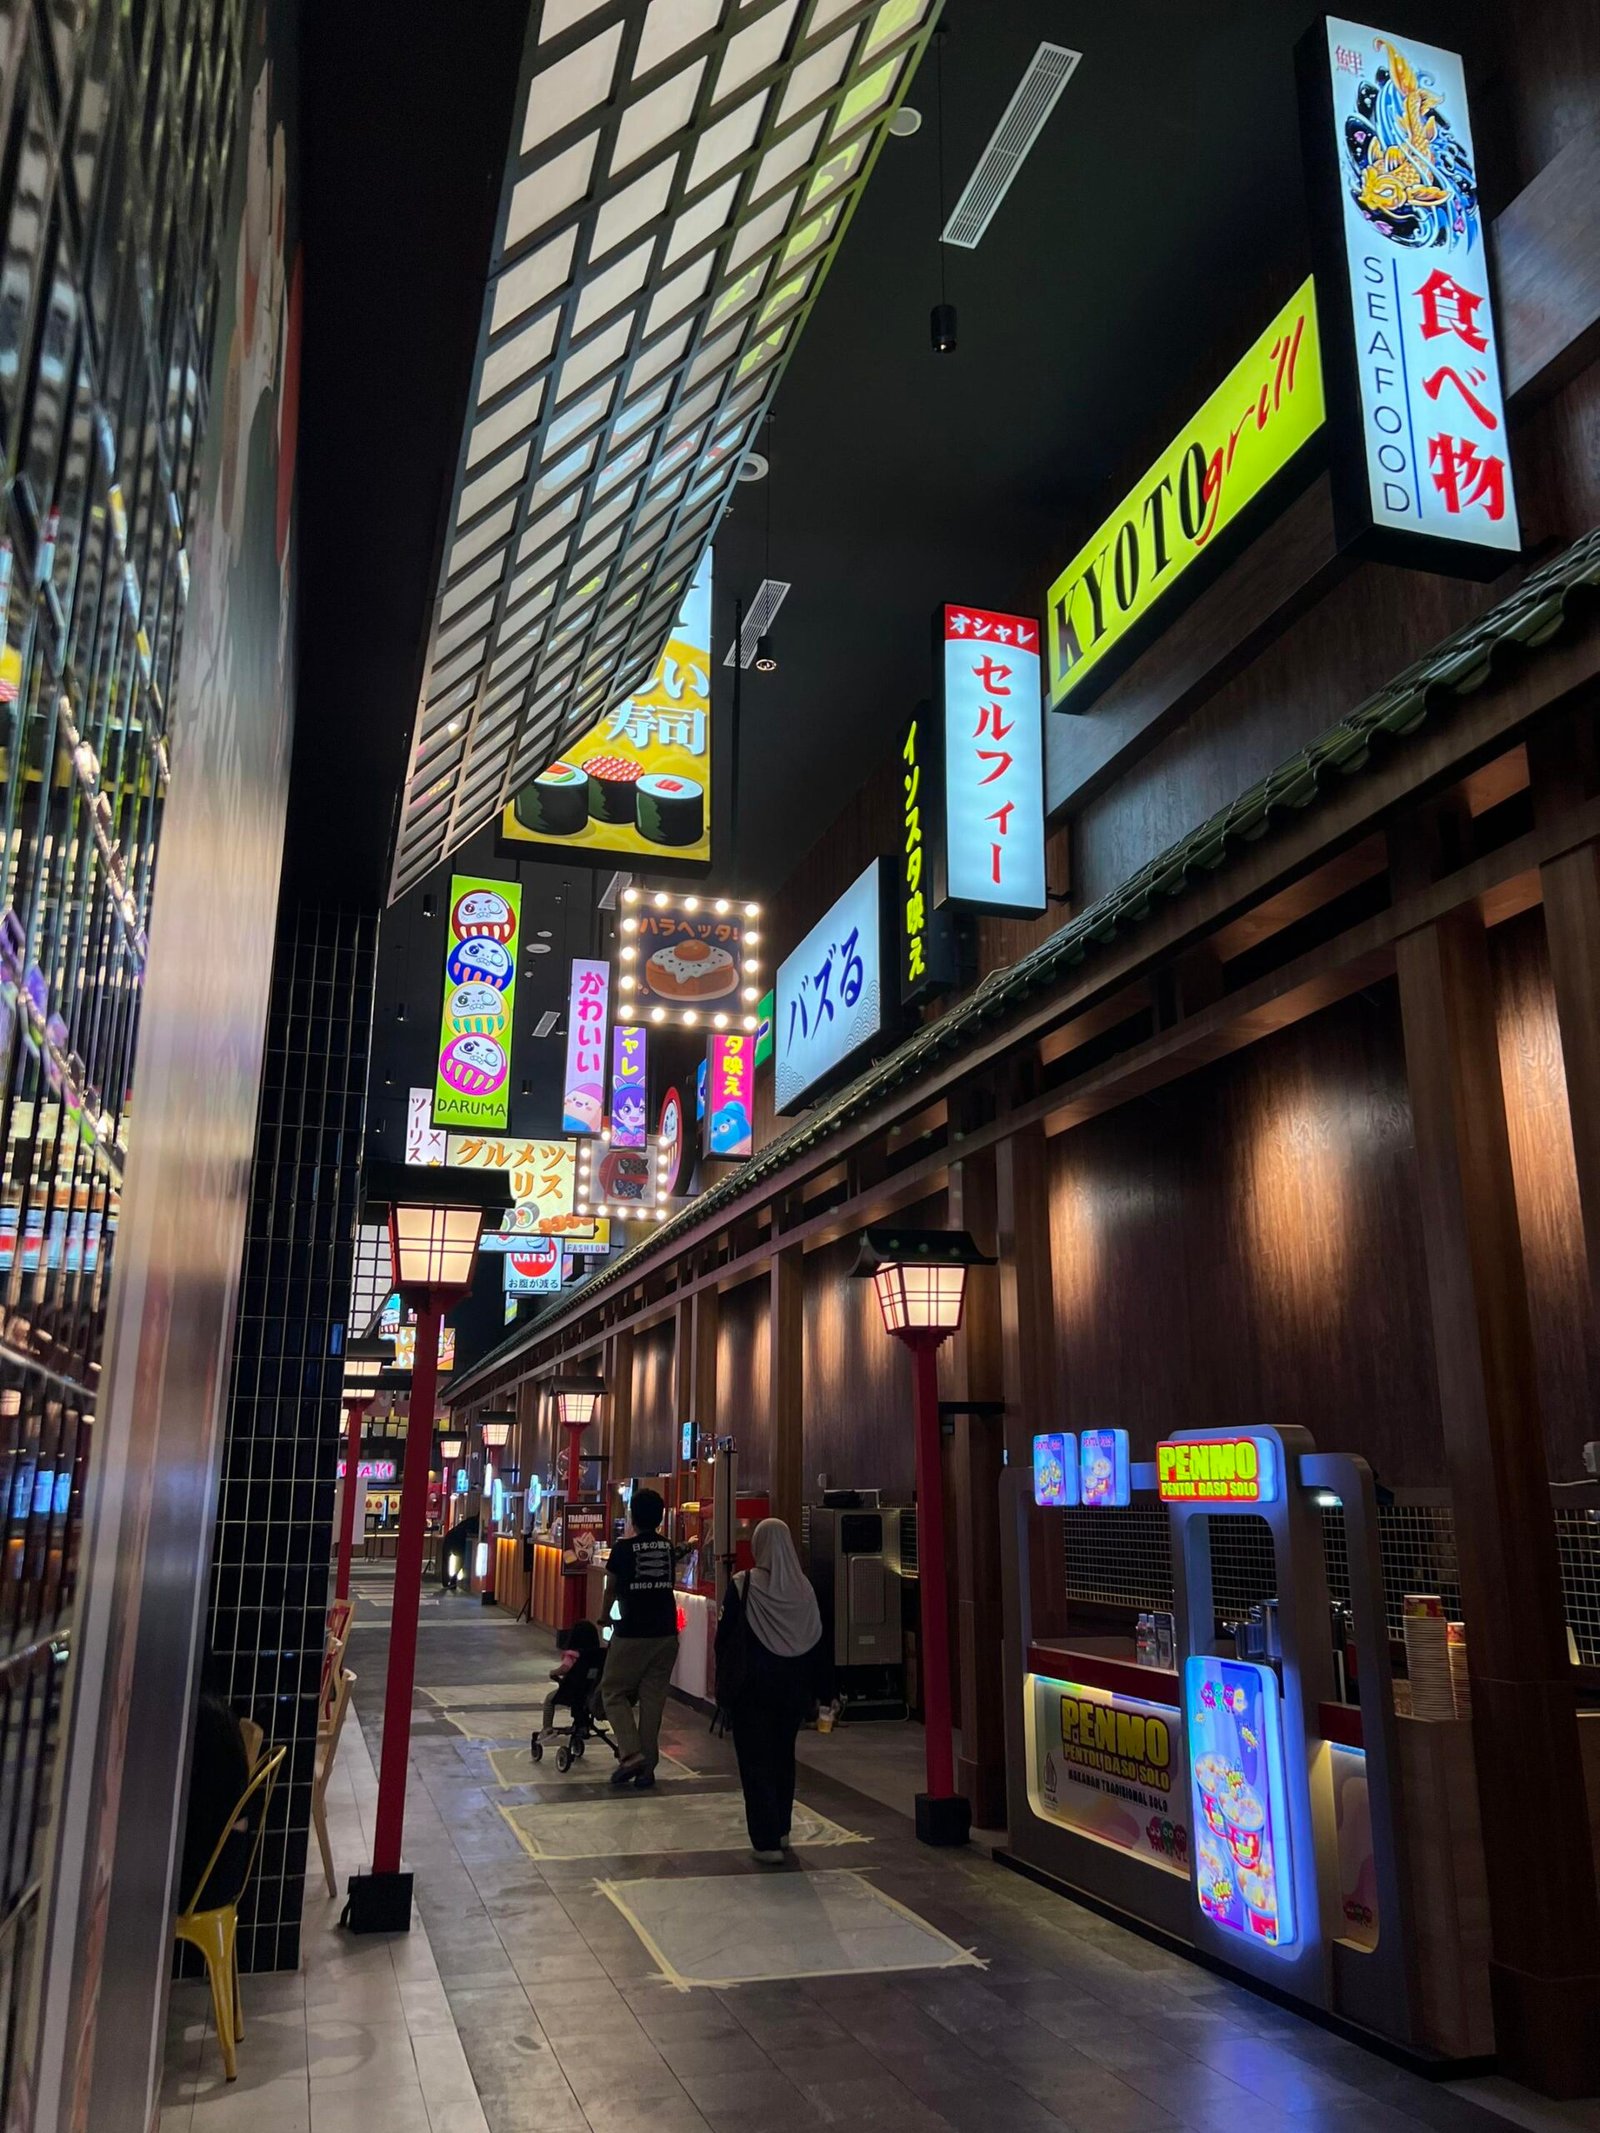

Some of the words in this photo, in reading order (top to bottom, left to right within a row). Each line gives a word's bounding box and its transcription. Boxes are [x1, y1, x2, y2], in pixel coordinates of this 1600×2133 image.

[1363, 257, 1410, 513] SEAFOOD
[1412, 268, 1506, 521] 食べ物
[1054, 441, 1208, 681] KYOTO
[1195, 315, 1304, 546] grill
[949, 612, 1035, 644] オシャレ
[606, 698, 707, 756] 寿司
[972, 654, 1016, 884] セルフィー
[787, 926, 864, 1057] バズる
[576, 971, 605, 1073] かわいい
[437, 1098, 506, 1117] DARUMA
[566, 1244, 606, 1252] FASHION
[1158, 1442, 1257, 1480] PENMO
[1161, 1482, 1197, 1496] PENTOL
[1230, 1482, 1258, 1496] SOLO
[630, 1582, 653, 1590] ERIGO
[1061, 1697, 1170, 1768] PENMO
[1064, 1742, 1102, 1770] PENTOL
[1139, 1764, 1171, 1792] SOLO
